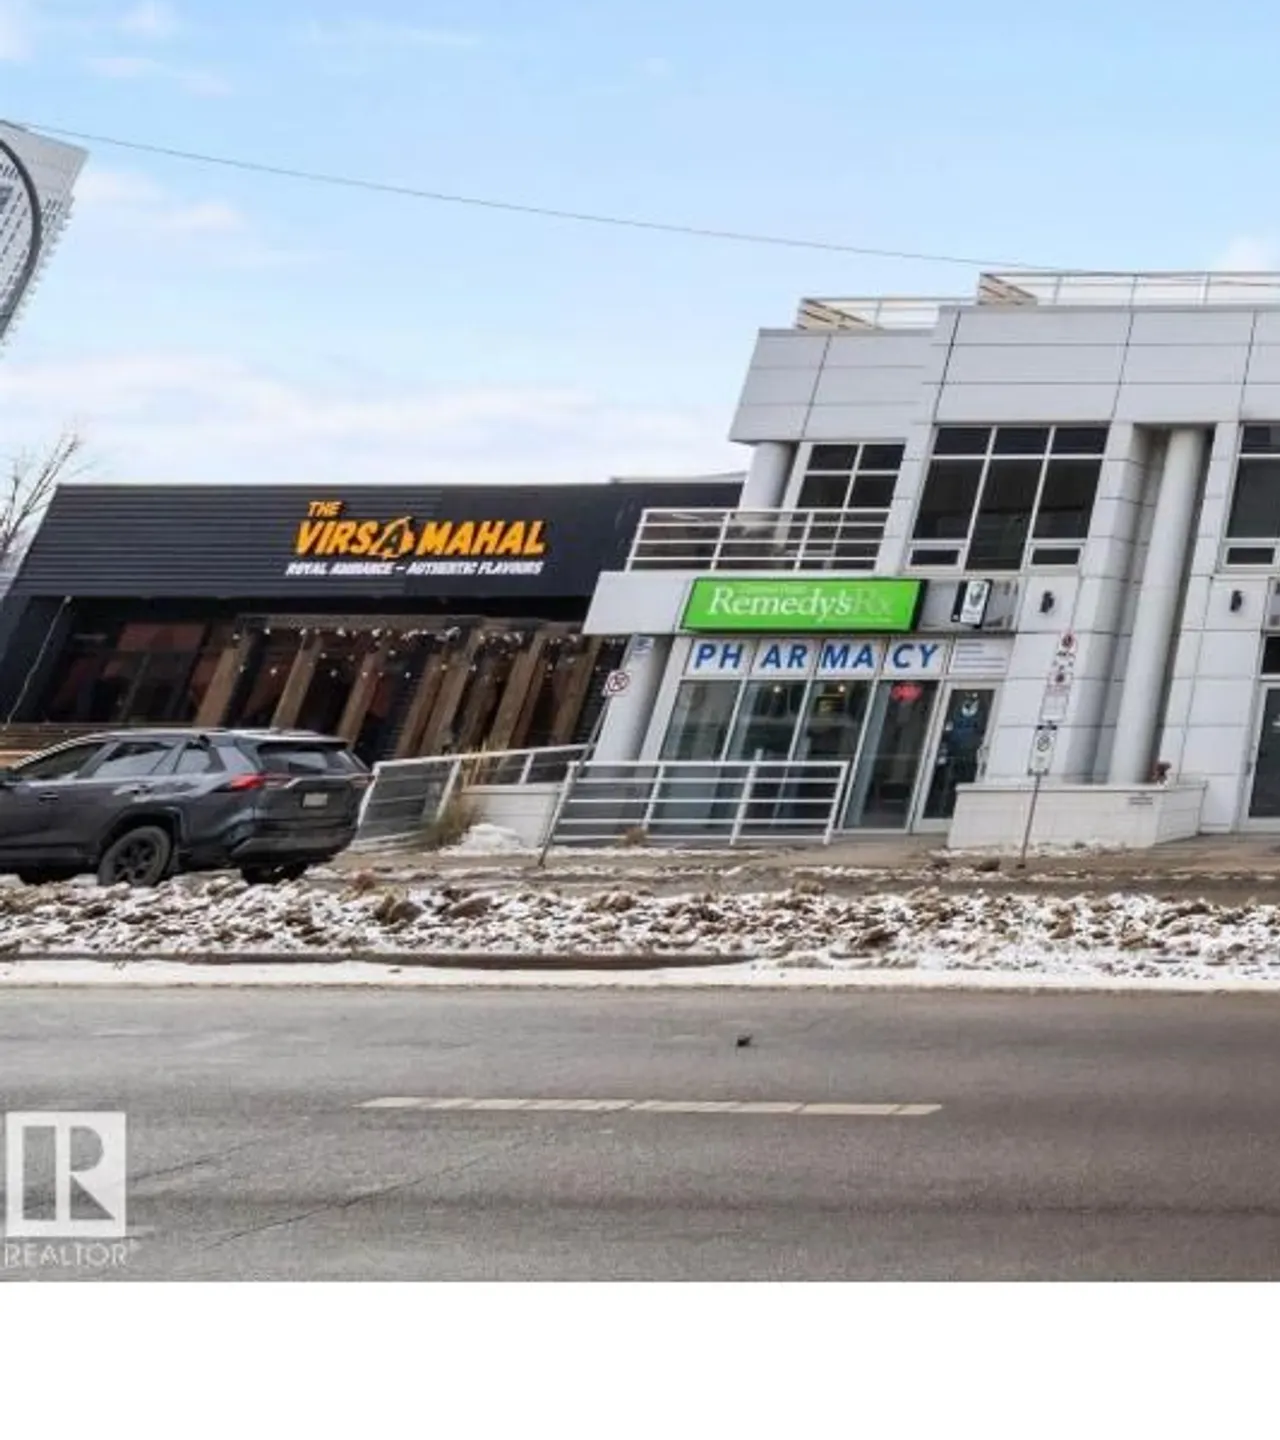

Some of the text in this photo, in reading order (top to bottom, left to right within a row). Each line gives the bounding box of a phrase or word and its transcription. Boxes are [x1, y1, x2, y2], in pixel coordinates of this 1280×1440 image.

[308, 500, 343, 517] THE
[416, 520, 545, 556] MAHAL
[286, 561, 328, 576] ROYAL
[693, 643, 939, 669] PHARMACY
